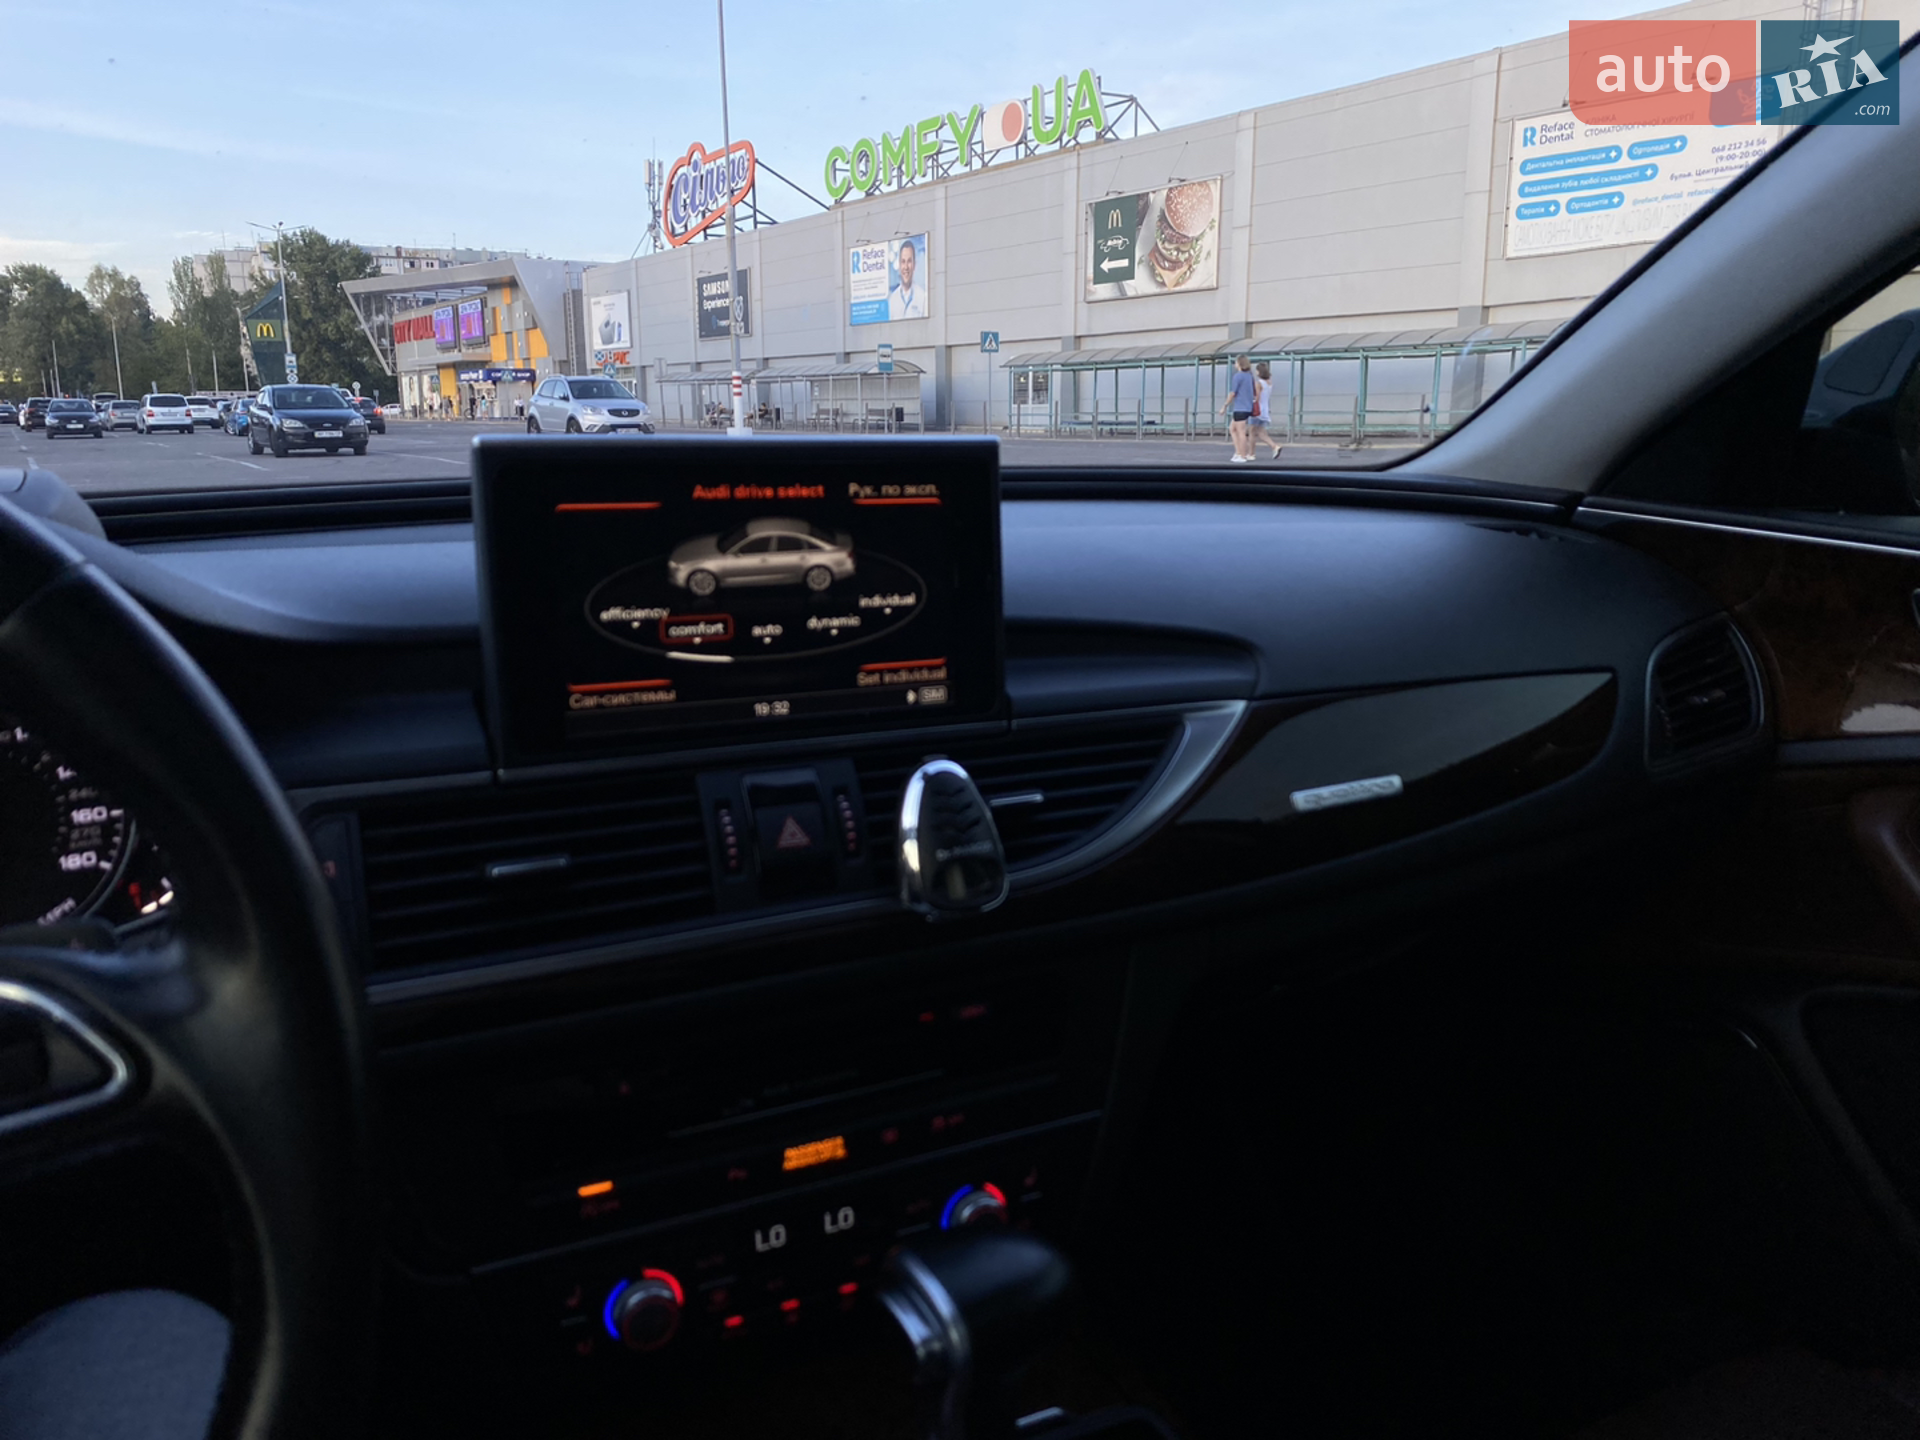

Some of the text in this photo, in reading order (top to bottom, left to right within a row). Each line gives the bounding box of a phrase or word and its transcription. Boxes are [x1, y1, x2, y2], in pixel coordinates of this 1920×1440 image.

[825, 68, 1107, 200] COMFY UA
[1540, 121, 1576, 134] Reface
[1539, 131, 1575, 145] Dental
[1727, 142, 1743, 152] 212
[1744, 139, 1755, 148] 34
[862, 248, 885, 260] Reface
[862, 260, 886, 273] Dental
[692, 483, 825, 499] Audi drive select
[848, 482, 879, 499] Рук.
[880, 484, 901, 497] по
[858, 592, 917, 609] individual
[599, 606, 671, 623] efficiency
[806, 613, 862, 632] dynamic
[668, 621, 725, 637] comfort
[751, 623, 784, 638] auto
[856, 666, 948, 687] Set individual
[70, 805, 108, 826] 160
[59, 850, 98, 871] 180
[824, 1206, 855, 1235] LO
[755, 1223, 787, 1253] LO
